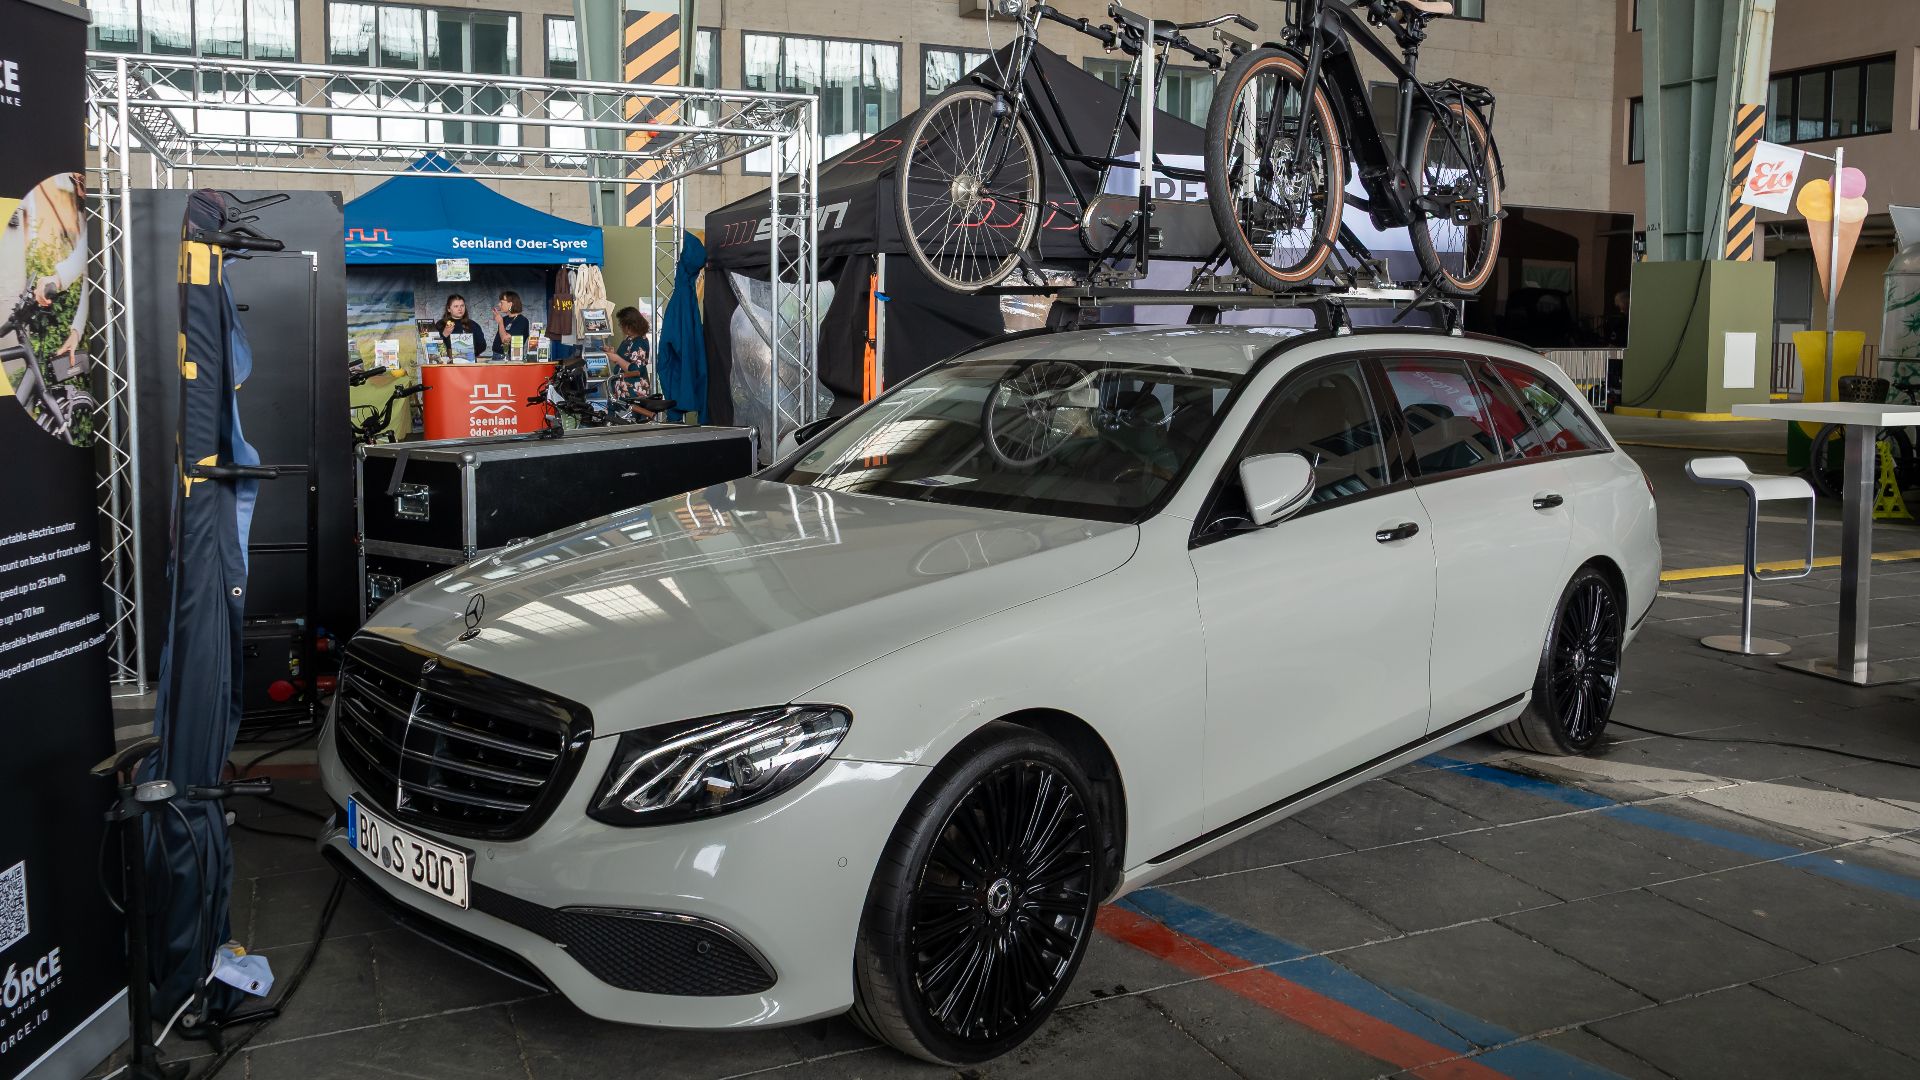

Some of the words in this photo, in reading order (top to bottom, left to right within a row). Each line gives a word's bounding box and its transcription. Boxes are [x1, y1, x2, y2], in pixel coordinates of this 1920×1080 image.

[0, 95, 21, 107] IKE
[1749, 160, 1793, 191] Eis
[452, 236, 512, 249] Seenland
[515, 238, 588, 252] Oder-Spree
[469, 415, 518, 427] Seenland
[0, 532, 27, 546] ortable
[27, 526, 55, 540] electric
[56, 522, 76, 533] motor
[19, 558, 29, 567] on
[29, 552, 47, 565] back
[48, 551, 55, 561] or
[56, 546, 74, 559] front
[74, 541, 91, 552] wheel
[0, 586, 18, 601] peed
[19, 584, 29, 595] up
[29, 581, 37, 591] to
[38, 578, 47, 589] 25
[47, 573, 66, 586] km/h
[4, 615, 14, 626] up
[14, 612, 23, 621] to
[23, 607, 32, 619] 70
[32, 606, 45, 616] km
[0, 637, 27, 653] sferable
[27, 627, 58, 643] between
[58, 620, 86, 634] different
[86, 612, 100, 623] bikes
[0, 663, 21, 679] eloped
[21, 658, 35, 671] and
[35, 641, 83, 666] manufactured
[82, 640, 89, 650] in
[360, 811, 380, 859] BO
[391, 834, 405, 873] S
[411, 841, 455, 897] 300
[0, 946, 61, 1008] ORCE
[11, 996, 36, 1019] YOUR
[40, 976, 62, 998] BIKE
[0, 1009, 48, 1054] ORCE.IO
